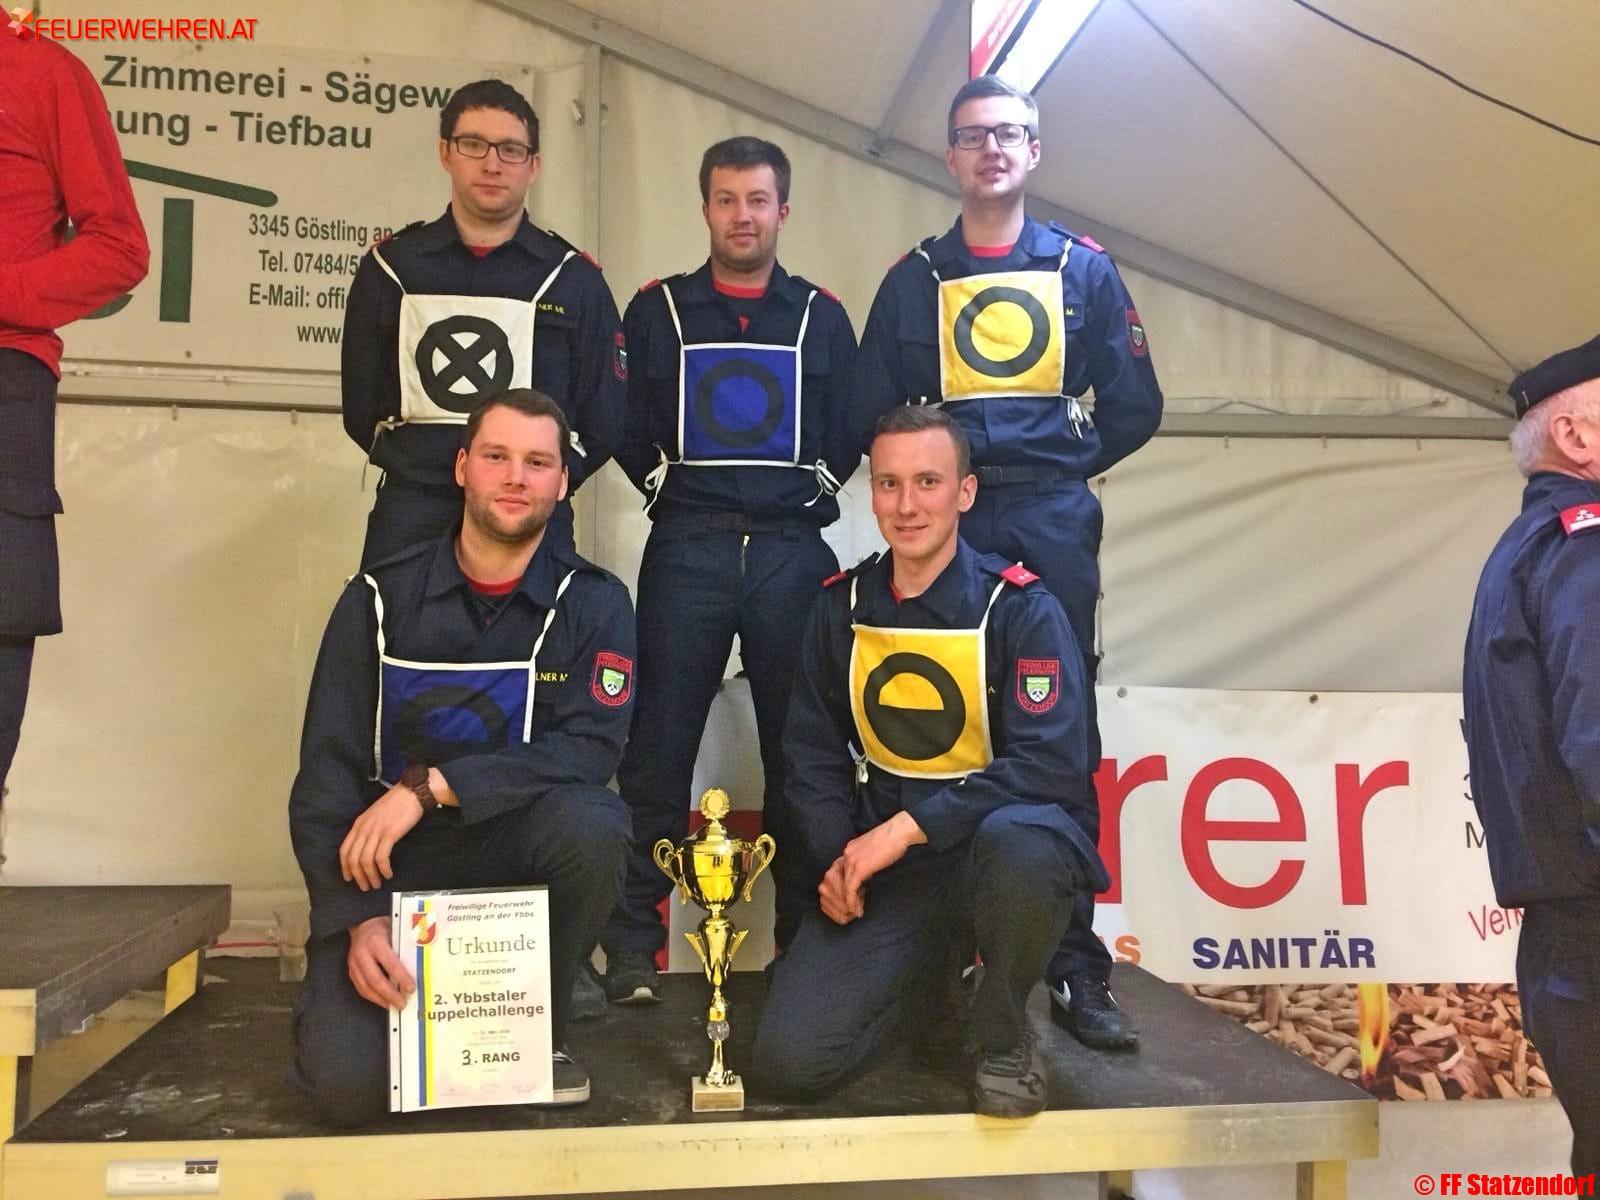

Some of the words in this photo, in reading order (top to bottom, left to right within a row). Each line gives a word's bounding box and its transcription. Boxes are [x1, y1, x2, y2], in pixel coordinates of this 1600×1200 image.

[102, 55, 286, 98] Zimmerei
[107, 109, 190, 146] ung
[230, 110, 372, 149] Tiefbau
[249, 213, 289, 237] 3345
[295, 216, 368, 248] Göstling
[258, 249, 288, 273] Tel.
[249, 283, 310, 308] E-Mail:
[447, 913, 482, 922] Göstling
[497, 912, 511, 920] der
[513, 911, 535, 919] Ybbs
[448, 903, 488, 911] Freiwillige
[489, 901, 535, 909] Feuerwehr
[446, 934, 536, 956] Urkunde
[1192, 930, 1376, 969] SANITÄR
[463, 968, 517, 976] STATZENDORF
[434, 994, 448, 1005] 2.
[453, 990, 527, 1004] Ybbstaler
[462, 1050, 478, 1066] 3.
[482, 1052, 521, 1063] RANG
